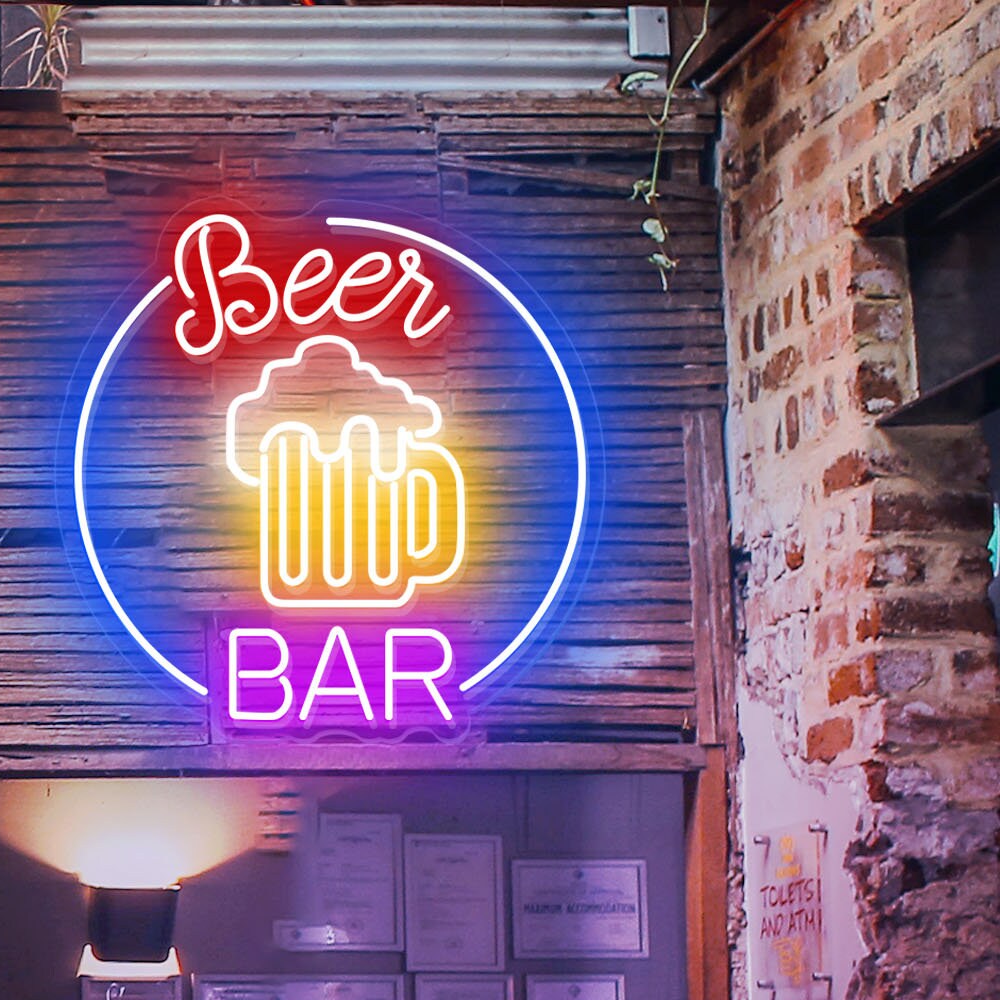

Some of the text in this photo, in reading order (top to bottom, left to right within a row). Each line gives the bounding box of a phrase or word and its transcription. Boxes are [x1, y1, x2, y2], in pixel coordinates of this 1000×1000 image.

[175, 213, 451, 356] Beer
[228, 626, 453, 721] BAR
[760, 908, 815, 939] AND ATM
